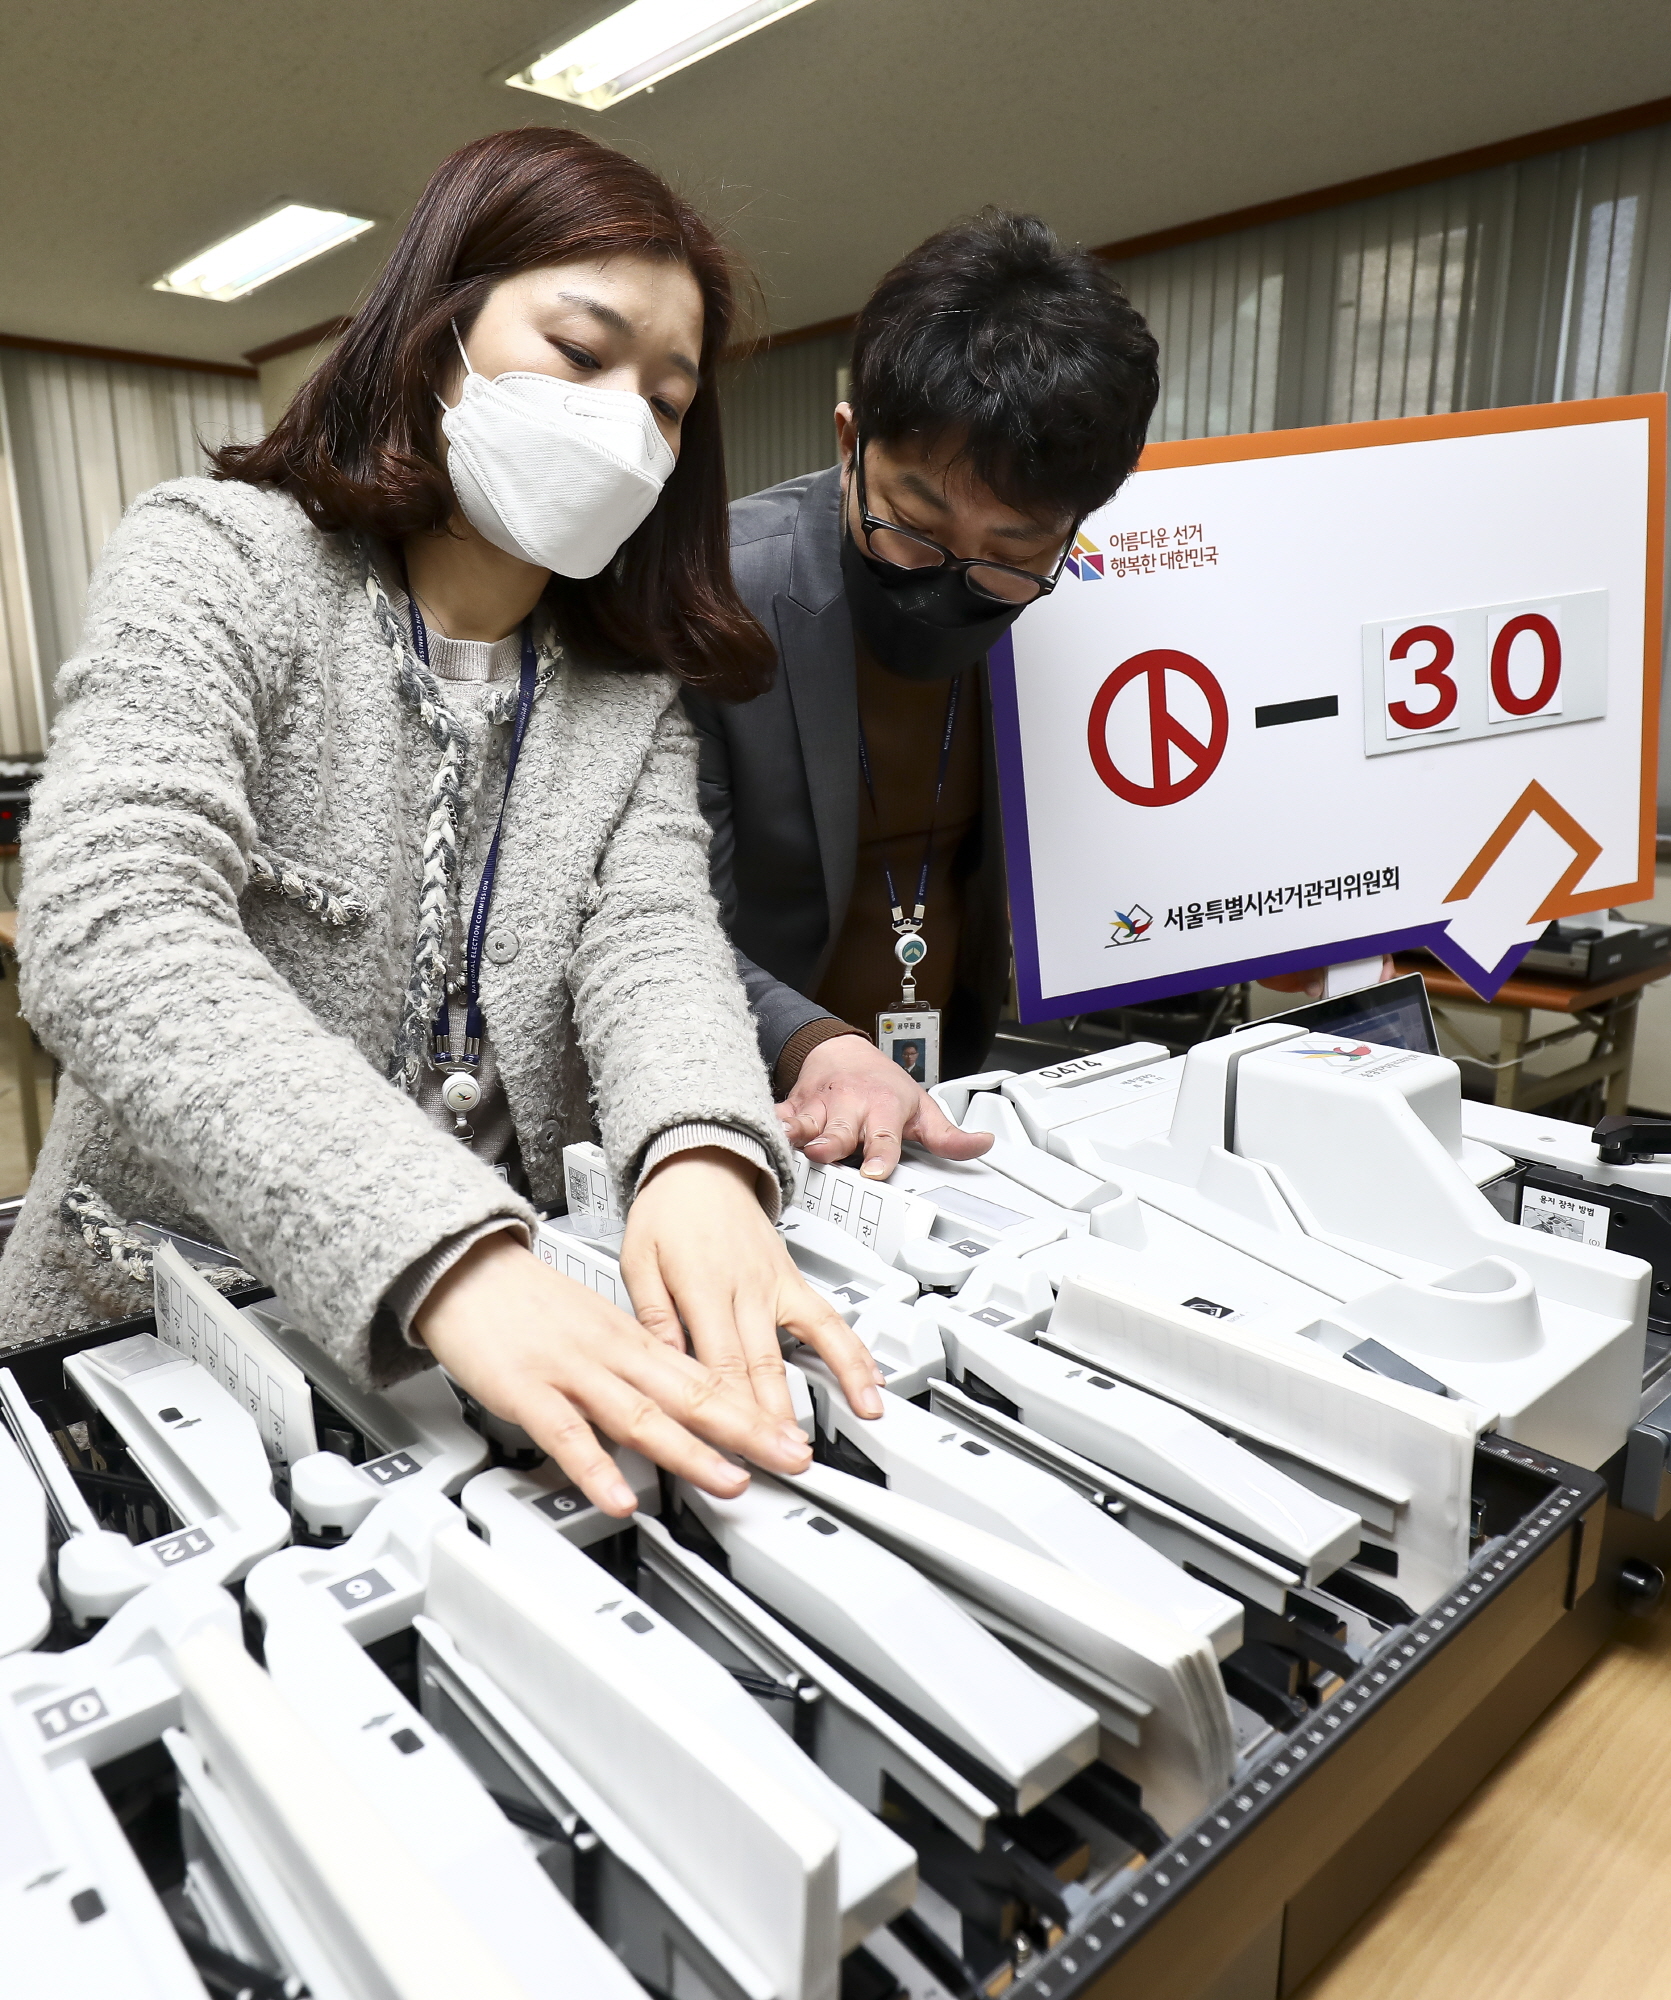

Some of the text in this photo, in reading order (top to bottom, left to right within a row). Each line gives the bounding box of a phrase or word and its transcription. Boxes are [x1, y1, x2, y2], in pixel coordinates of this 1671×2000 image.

[1109, 523, 1203, 552] 아름다운 선거
[1110, 546, 1219, 578] 행복한 대한민국
[1163, 866, 1400, 932] 서울특별시선거관리위원회
[470, 925, 480, 960] ELECTION
[476, 880, 489, 924] COMMISSION
[897, 1022, 922, 1030] 공무원증
[1038, 1059, 1102, 1079] 0474
[1539, 1195, 1595, 1217] 용지 장착 방법
[982, 1312, 1001, 1324] 1
[371, 1456, 412, 1481] 11
[553, 1496, 577, 1512] 6
[156, 1534, 209, 1563] 12
[40, 1693, 101, 1735] 10
